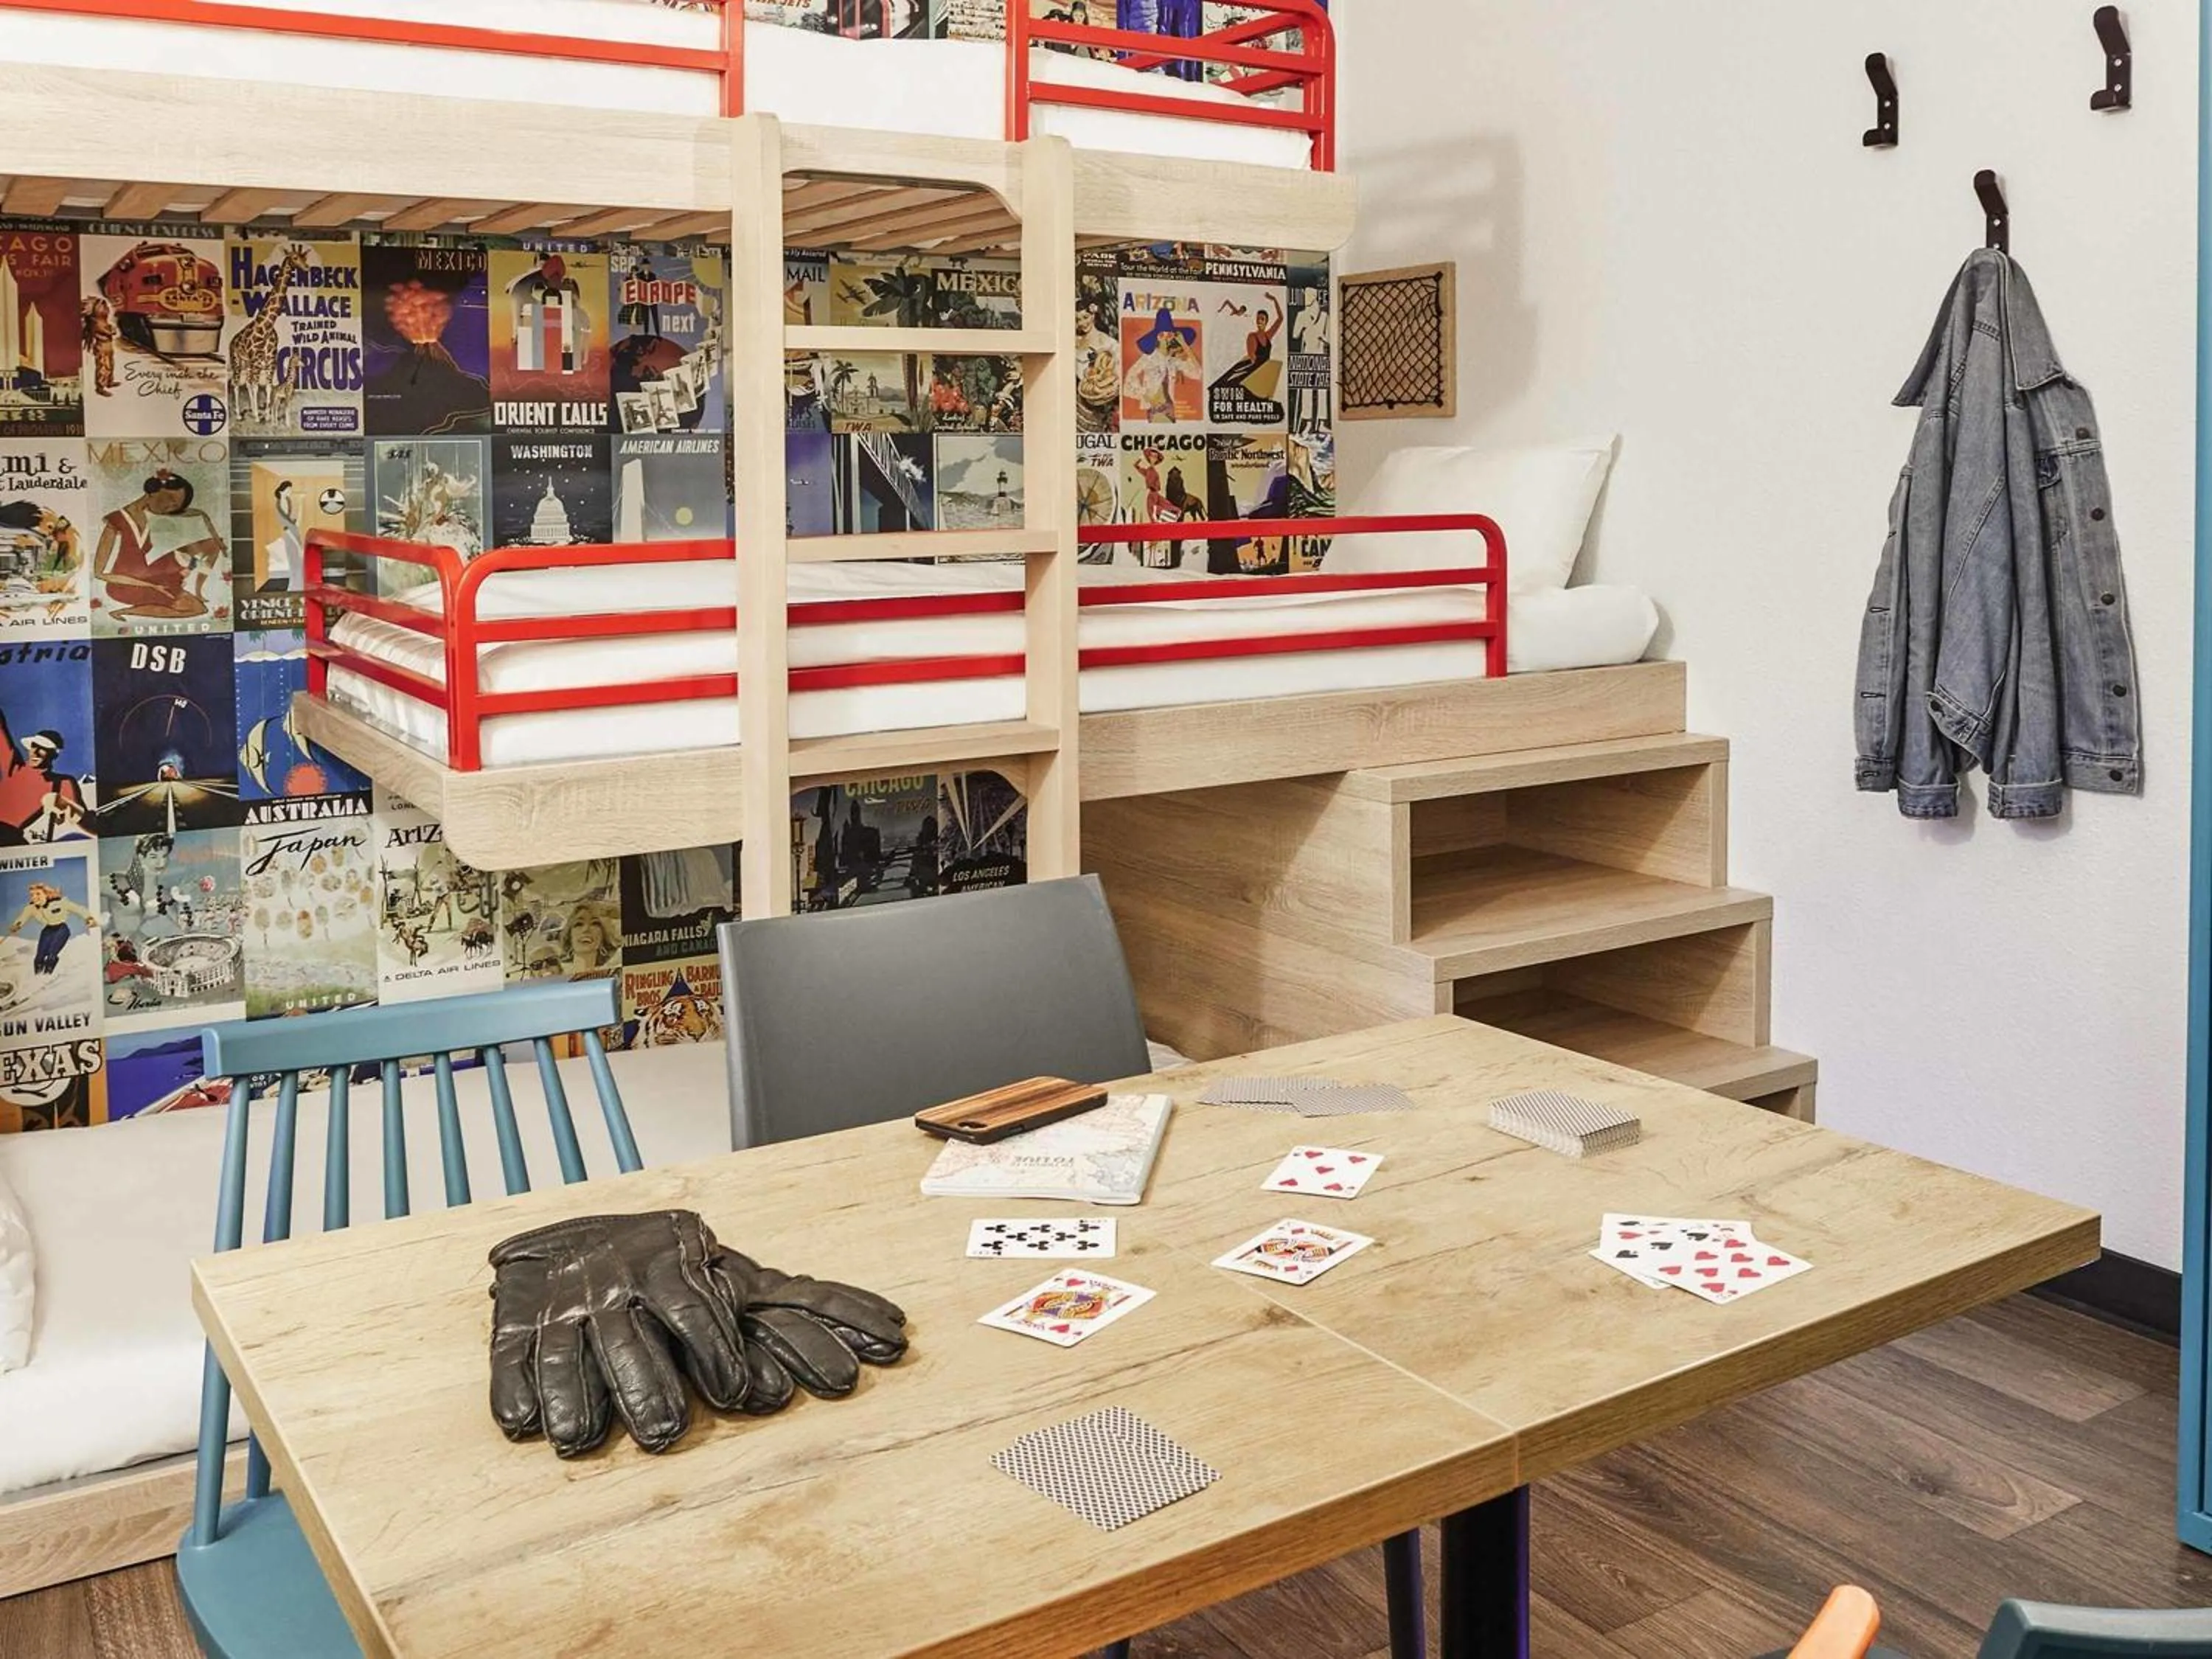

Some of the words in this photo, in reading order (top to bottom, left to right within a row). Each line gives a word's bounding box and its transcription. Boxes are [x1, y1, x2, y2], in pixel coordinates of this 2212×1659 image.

[0, 236, 72, 252] AGO
[523, 241, 588, 253] UNITED
[32, 254, 72, 267] FAIR
[418, 251, 487, 271] MEXICO
[1137, 262, 1148, 272] the
[787, 265, 826, 282] MAIL
[1206, 262, 1287, 280] PENNSYLVANIA
[625, 281, 695, 305] EUROPE
[1123, 291, 1200, 313] ARIZONA
[291, 319, 337, 332] TRAINED
[662, 313, 695, 333] next
[292, 333, 319, 345] WILD
[321, 330, 358, 345] ANIMAL
[277, 346, 364, 392] CIRCUS
[1213, 387, 1245, 400] SWIM
[185, 410, 212, 420] Santa
[213, 410, 225, 420] Fe
[493, 402, 556, 425] ORIENT
[561, 402, 608, 425] CALLS
[1213, 402, 1233, 412] FOR
[1237, 402, 1274, 412] HEALTH
[843, 421, 872, 431] TWA
[619, 439, 674, 454] AMERICAN
[675, 439, 720, 453] AIRLINES
[1121, 434, 1206, 451] CHICAGO
[86, 441, 227, 465] MEXICO
[510, 444, 593, 459] WASHINGTON
[0, 451, 51, 476] mi
[59, 457, 77, 474] &
[1091, 457, 1114, 467] TWA
[8, 475, 87, 491] Lauderdale
[10, 618, 35, 627] AIR
[42, 616, 88, 626] LINES
[134, 623, 211, 635] UNITED
[131, 643, 187, 673] DSB
[244, 797, 368, 827] AUSTRALIA
[246, 827, 367, 876] Japan
[672, 925, 703, 942] FALLS
[395, 970, 433, 981] DELTA
[438, 965, 459, 975] AIR
[464, 959, 501, 972] LINES
[285, 992, 356, 1009] UNITED
[0, 1020, 27, 1037] UN
[35, 1012, 91, 1033] VALLEY
